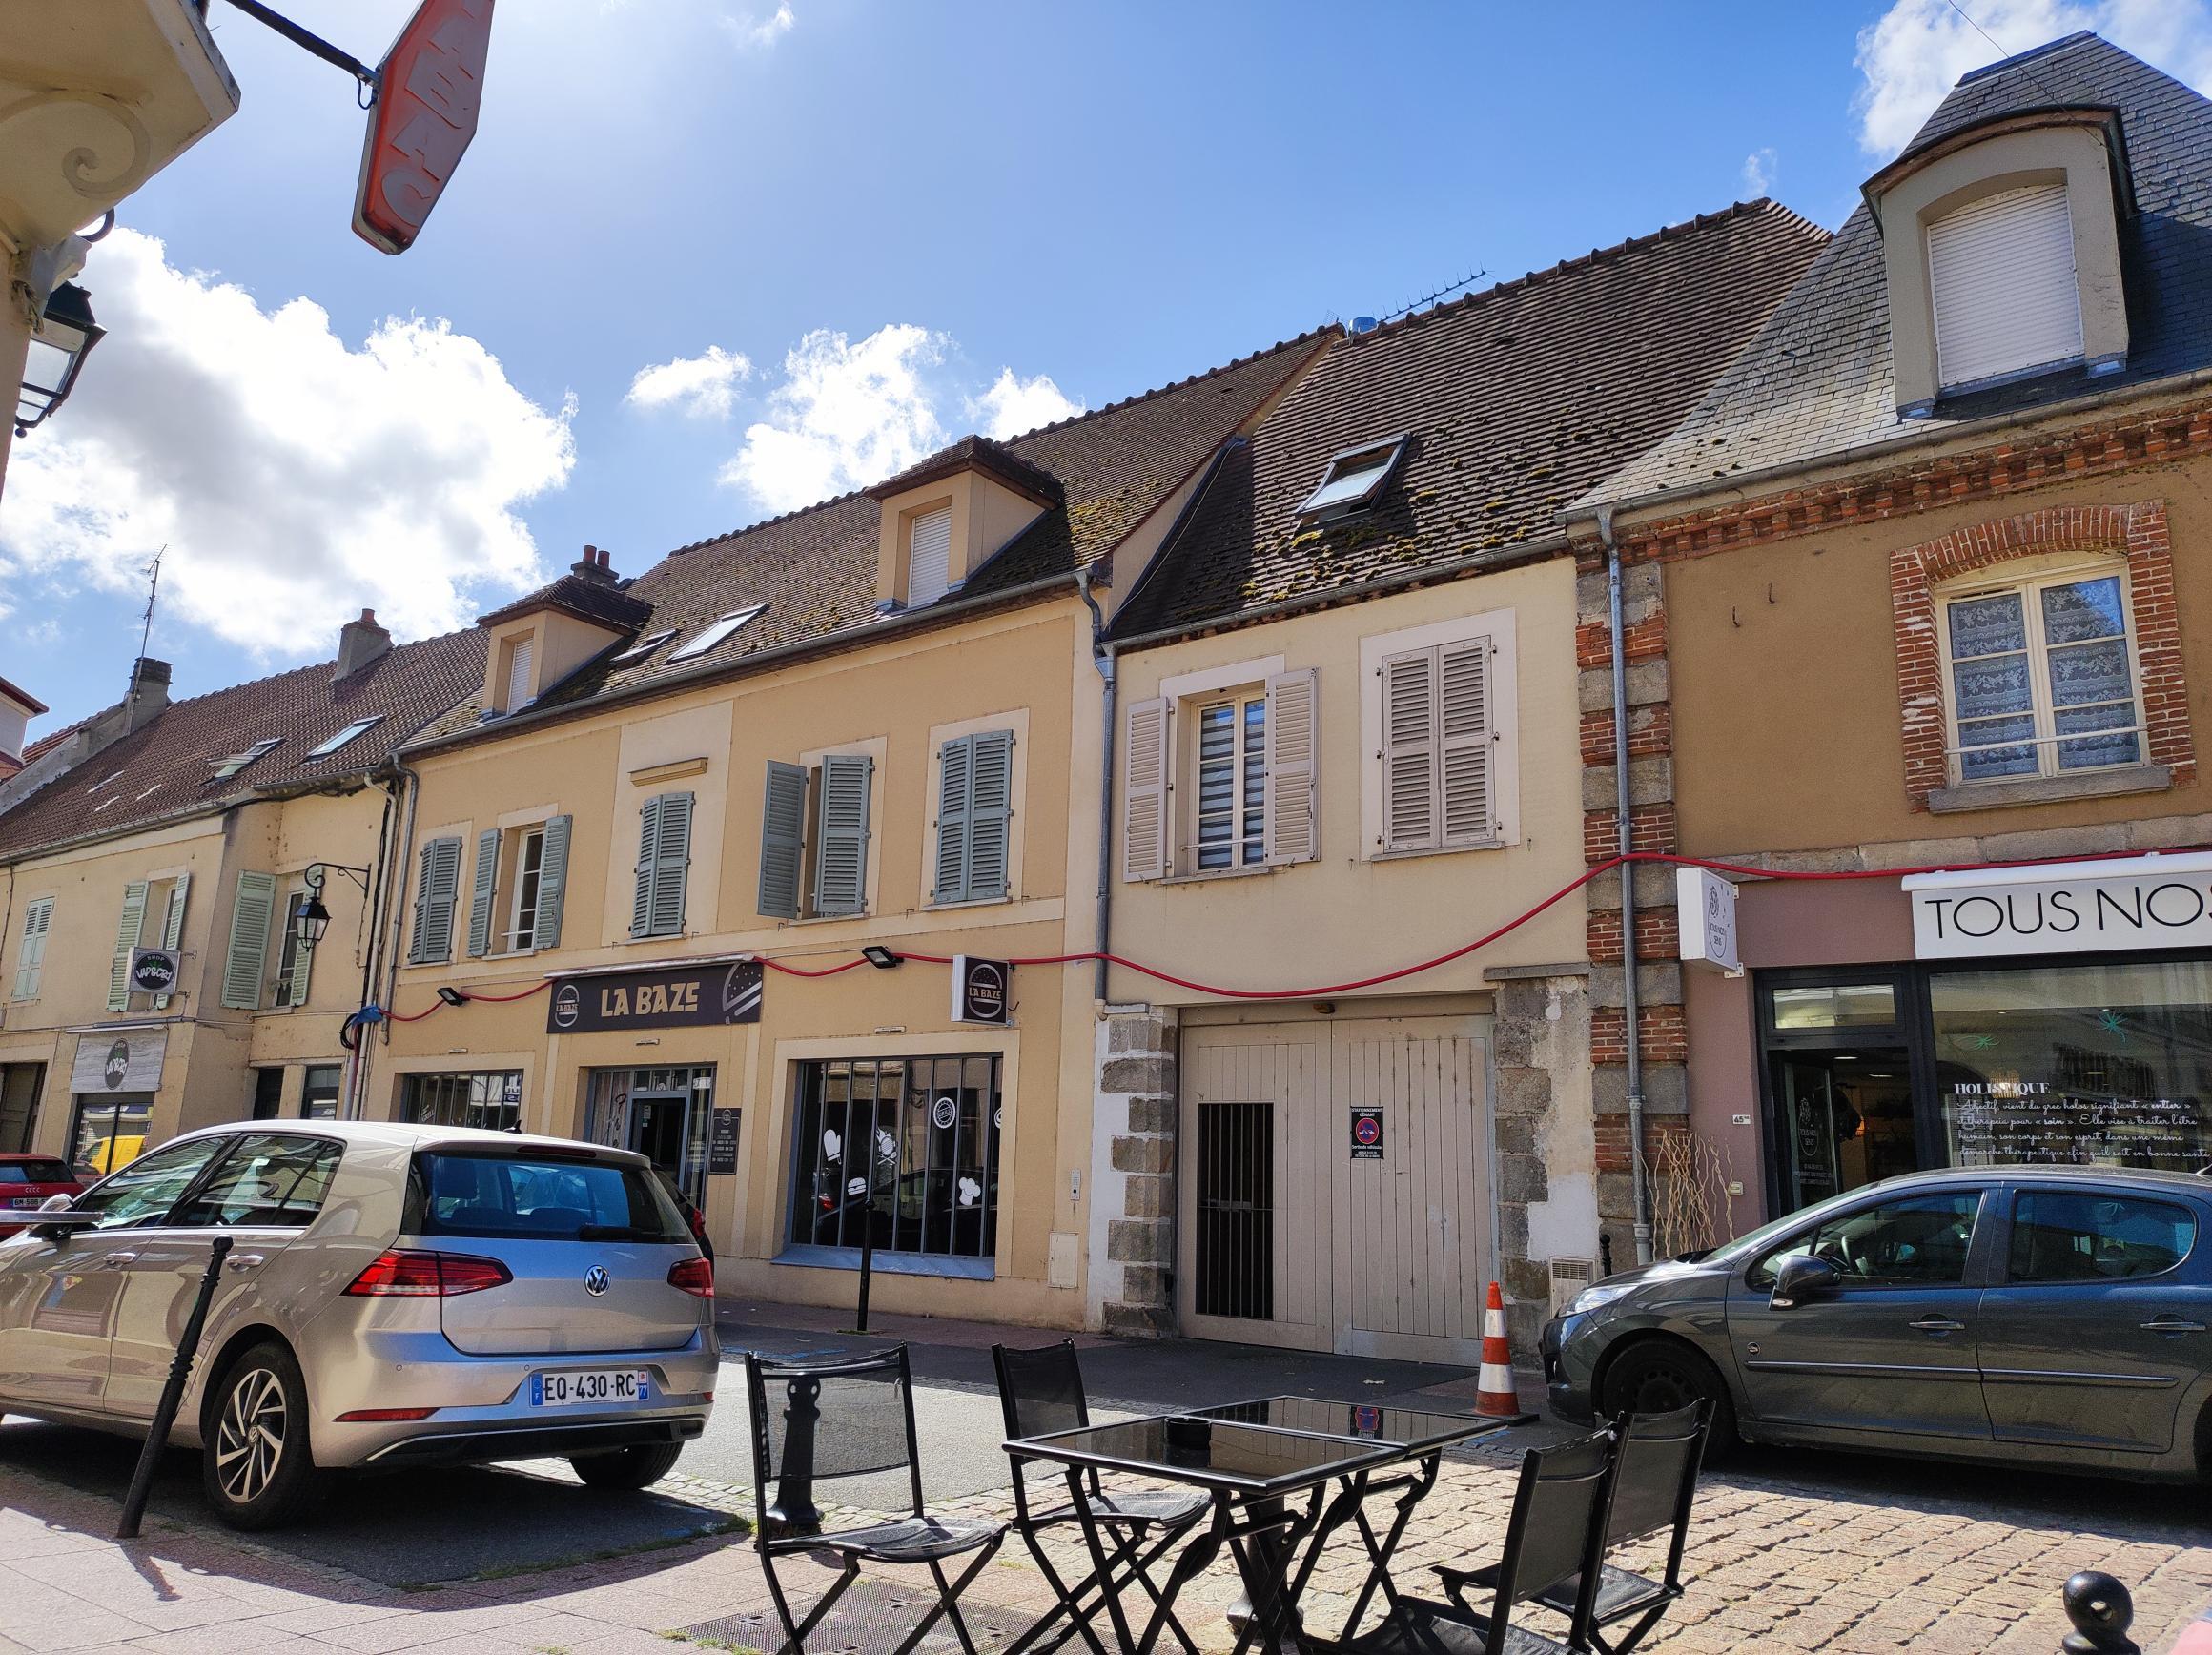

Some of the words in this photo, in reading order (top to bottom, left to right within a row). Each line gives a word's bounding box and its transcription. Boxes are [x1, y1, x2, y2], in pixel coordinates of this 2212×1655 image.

[381, 0, 483, 228] ABAC
[1924, 890, 2079, 939] TOUS
[2096, 883, 2212, 930] NO
[601, 988, 630, 1017] LA
[635, 981, 701, 1015] BAZE
[969, 987, 979, 997] LA
[981, 989, 1002, 1000] BAZE
[1955, 1082, 2051, 1095] HOLISTIQUE
[1956, 1099, 2000, 1114] Adjectif,
[2002, 1100, 2027, 1110] vient
[2028, 1100, 2041, 1110] du
[2042, 1103, 2062, 1115] grec
[2063, 1098, 2088, 1110] holos
[2090, 1098, 2139, 1114] signifiant
[2010, 1119, 2033, 1130] pour
[2079, 1114, 2106, 1125] Elle
[2135, 1115, 2170, 1125] traiter
[2017, 1134, 2042, 1146] corps
[2044, 1132, 2055, 1140] et
[2105, 1130, 2130, 1141] dans
[2067, 1145, 2088, 1161] afin
[2112, 1147, 2132, 1156] soit
[2147, 1145, 2181, 1157] bonne
[638, 1385, 648, 1396] 77
